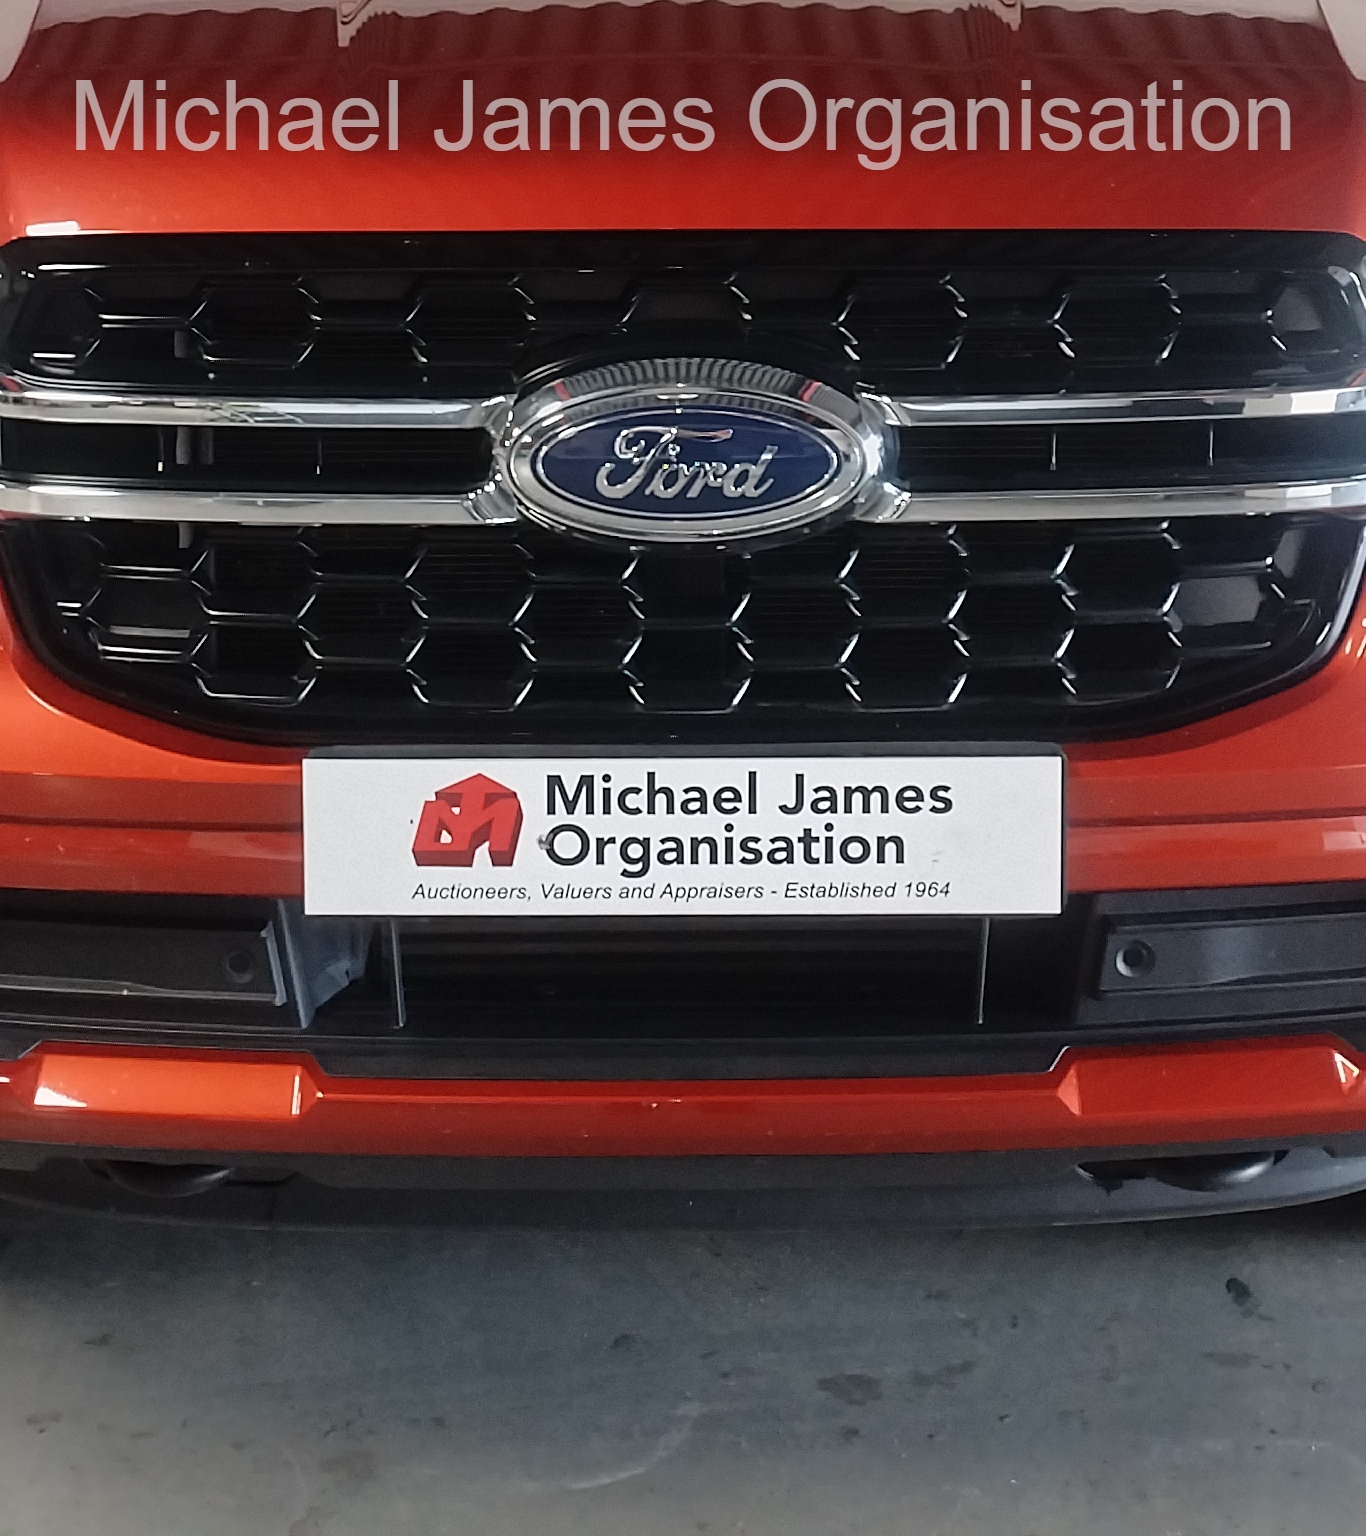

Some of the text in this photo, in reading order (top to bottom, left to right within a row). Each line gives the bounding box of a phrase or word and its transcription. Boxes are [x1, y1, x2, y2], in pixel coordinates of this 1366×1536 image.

[595, 426, 773, 502] Ford
[547, 771, 953, 816] Michael James
[545, 823, 906, 878] Organisation
[412, 881, 951, 904] Auctioneers, Valuers and Appraisers Established 1964
